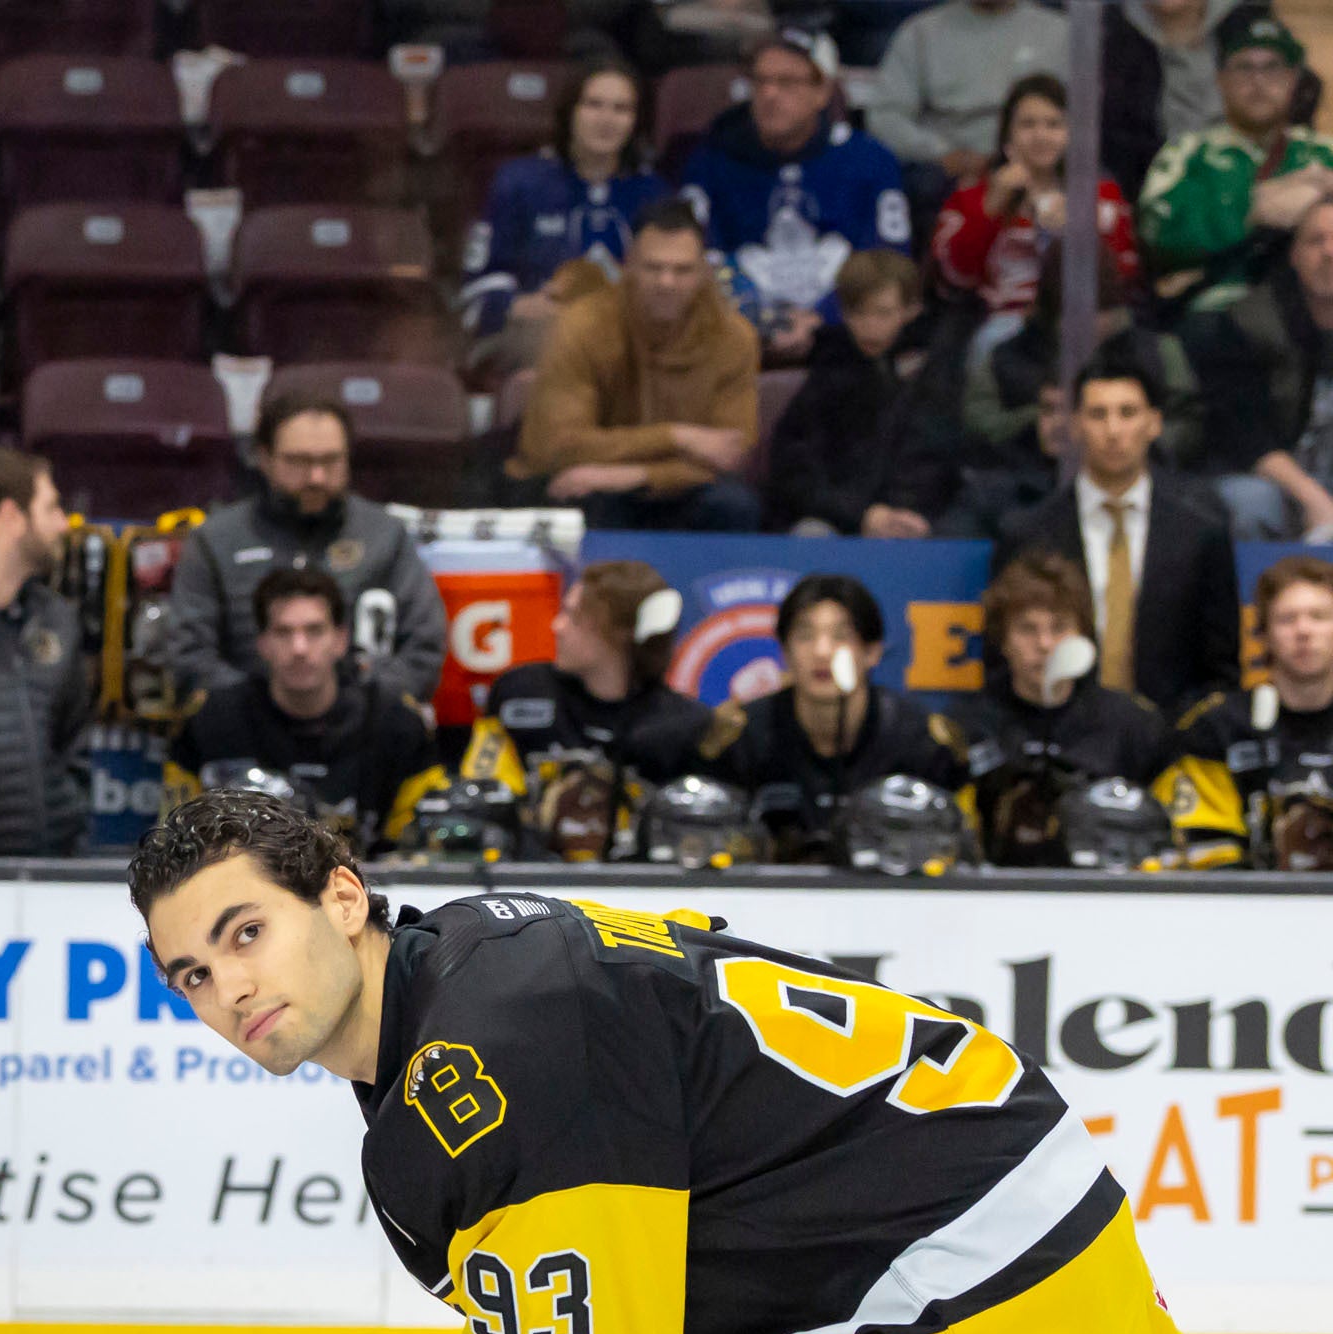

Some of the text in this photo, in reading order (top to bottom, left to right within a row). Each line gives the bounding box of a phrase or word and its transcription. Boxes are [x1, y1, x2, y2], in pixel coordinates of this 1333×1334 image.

[451, 599, 512, 674] G
[128, 1047, 156, 1081] &
[404, 1041, 508, 1159] B
[1083, 1086, 1283, 1224] AT
